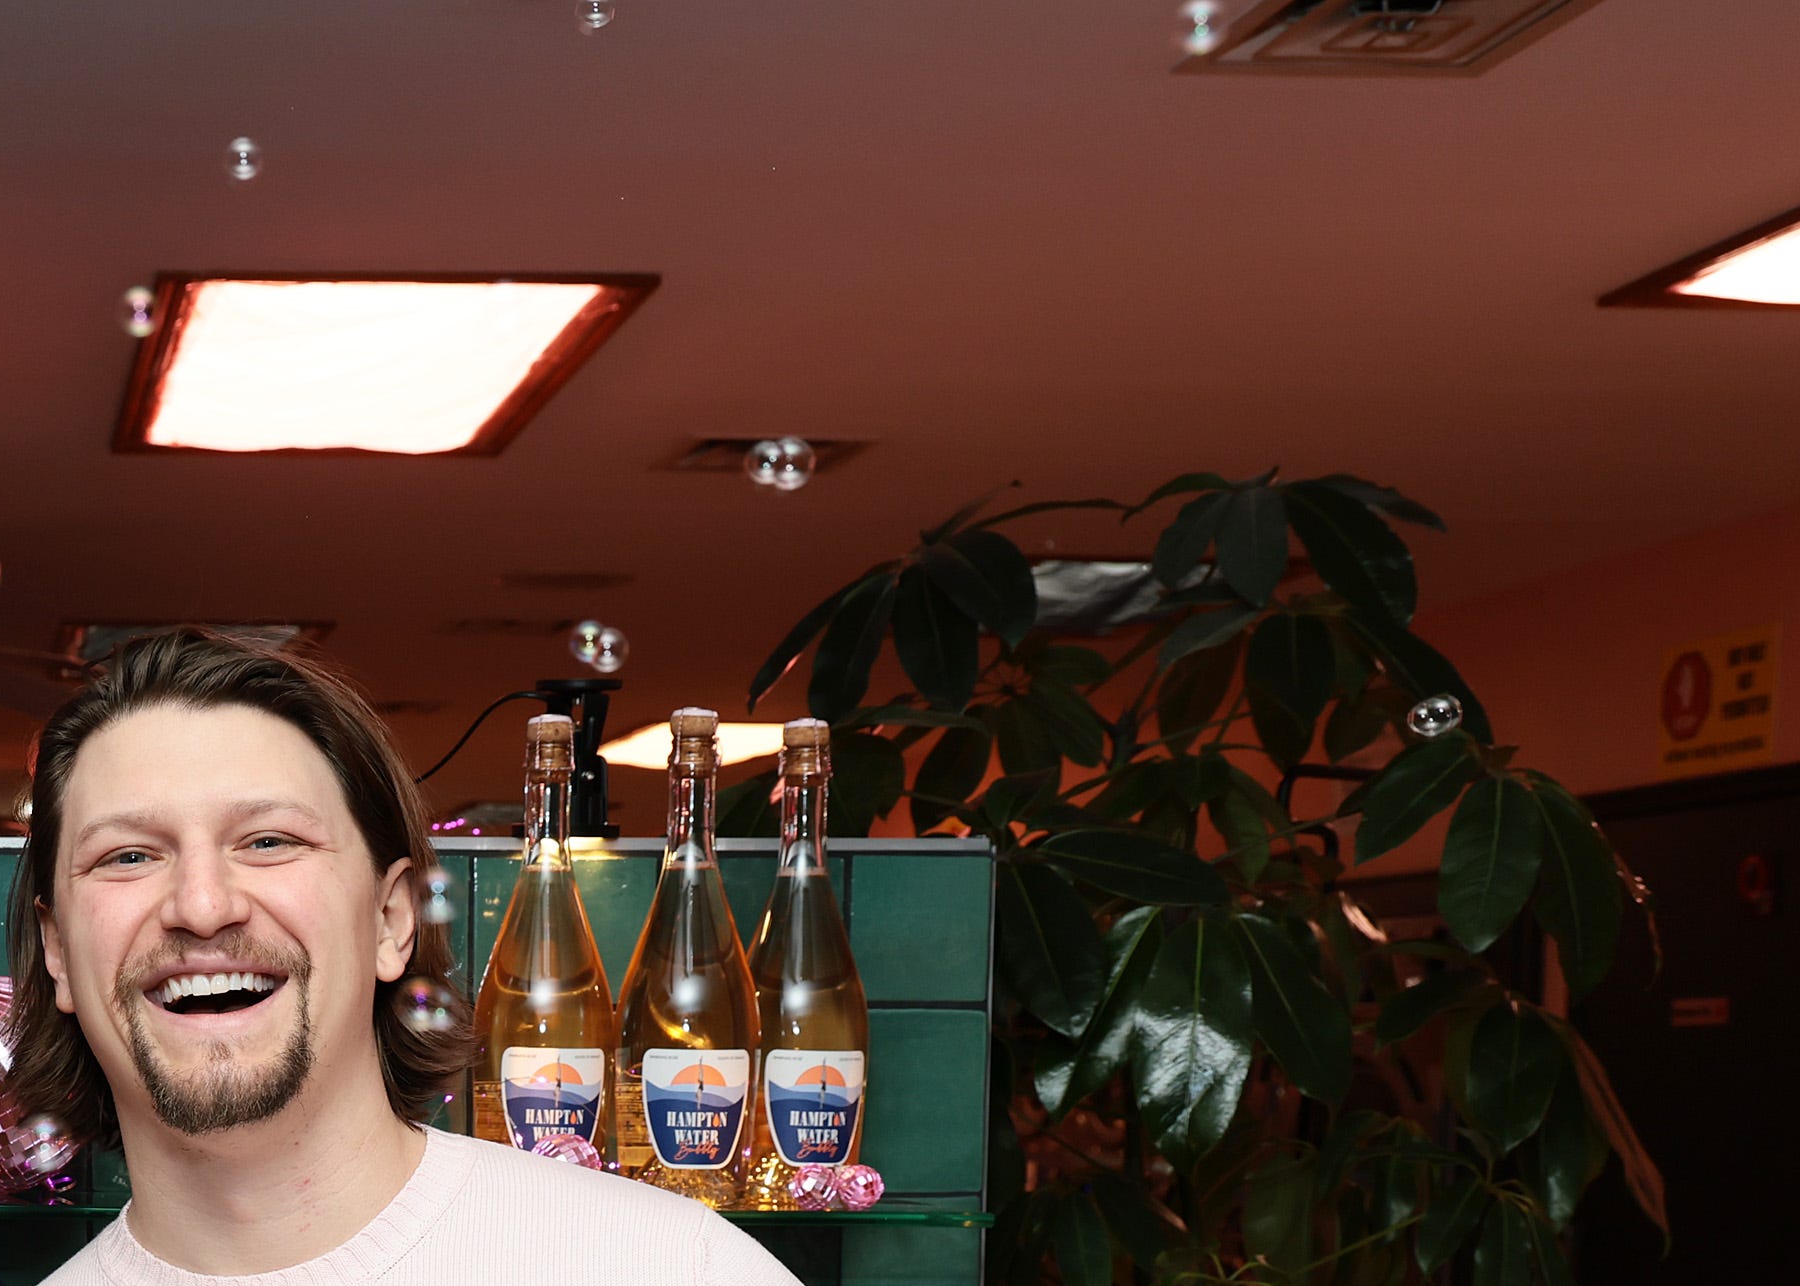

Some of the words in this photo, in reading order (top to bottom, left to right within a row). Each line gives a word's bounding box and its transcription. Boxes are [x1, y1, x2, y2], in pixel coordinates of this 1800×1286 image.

[525, 1108, 585, 1124] HAMPTON
[666, 1111, 728, 1127] HAMPTON
[789, 1110, 847, 1127] HAMPTON
[674, 1129, 720, 1145] WATER
[796, 1128, 839, 1144] WATER
